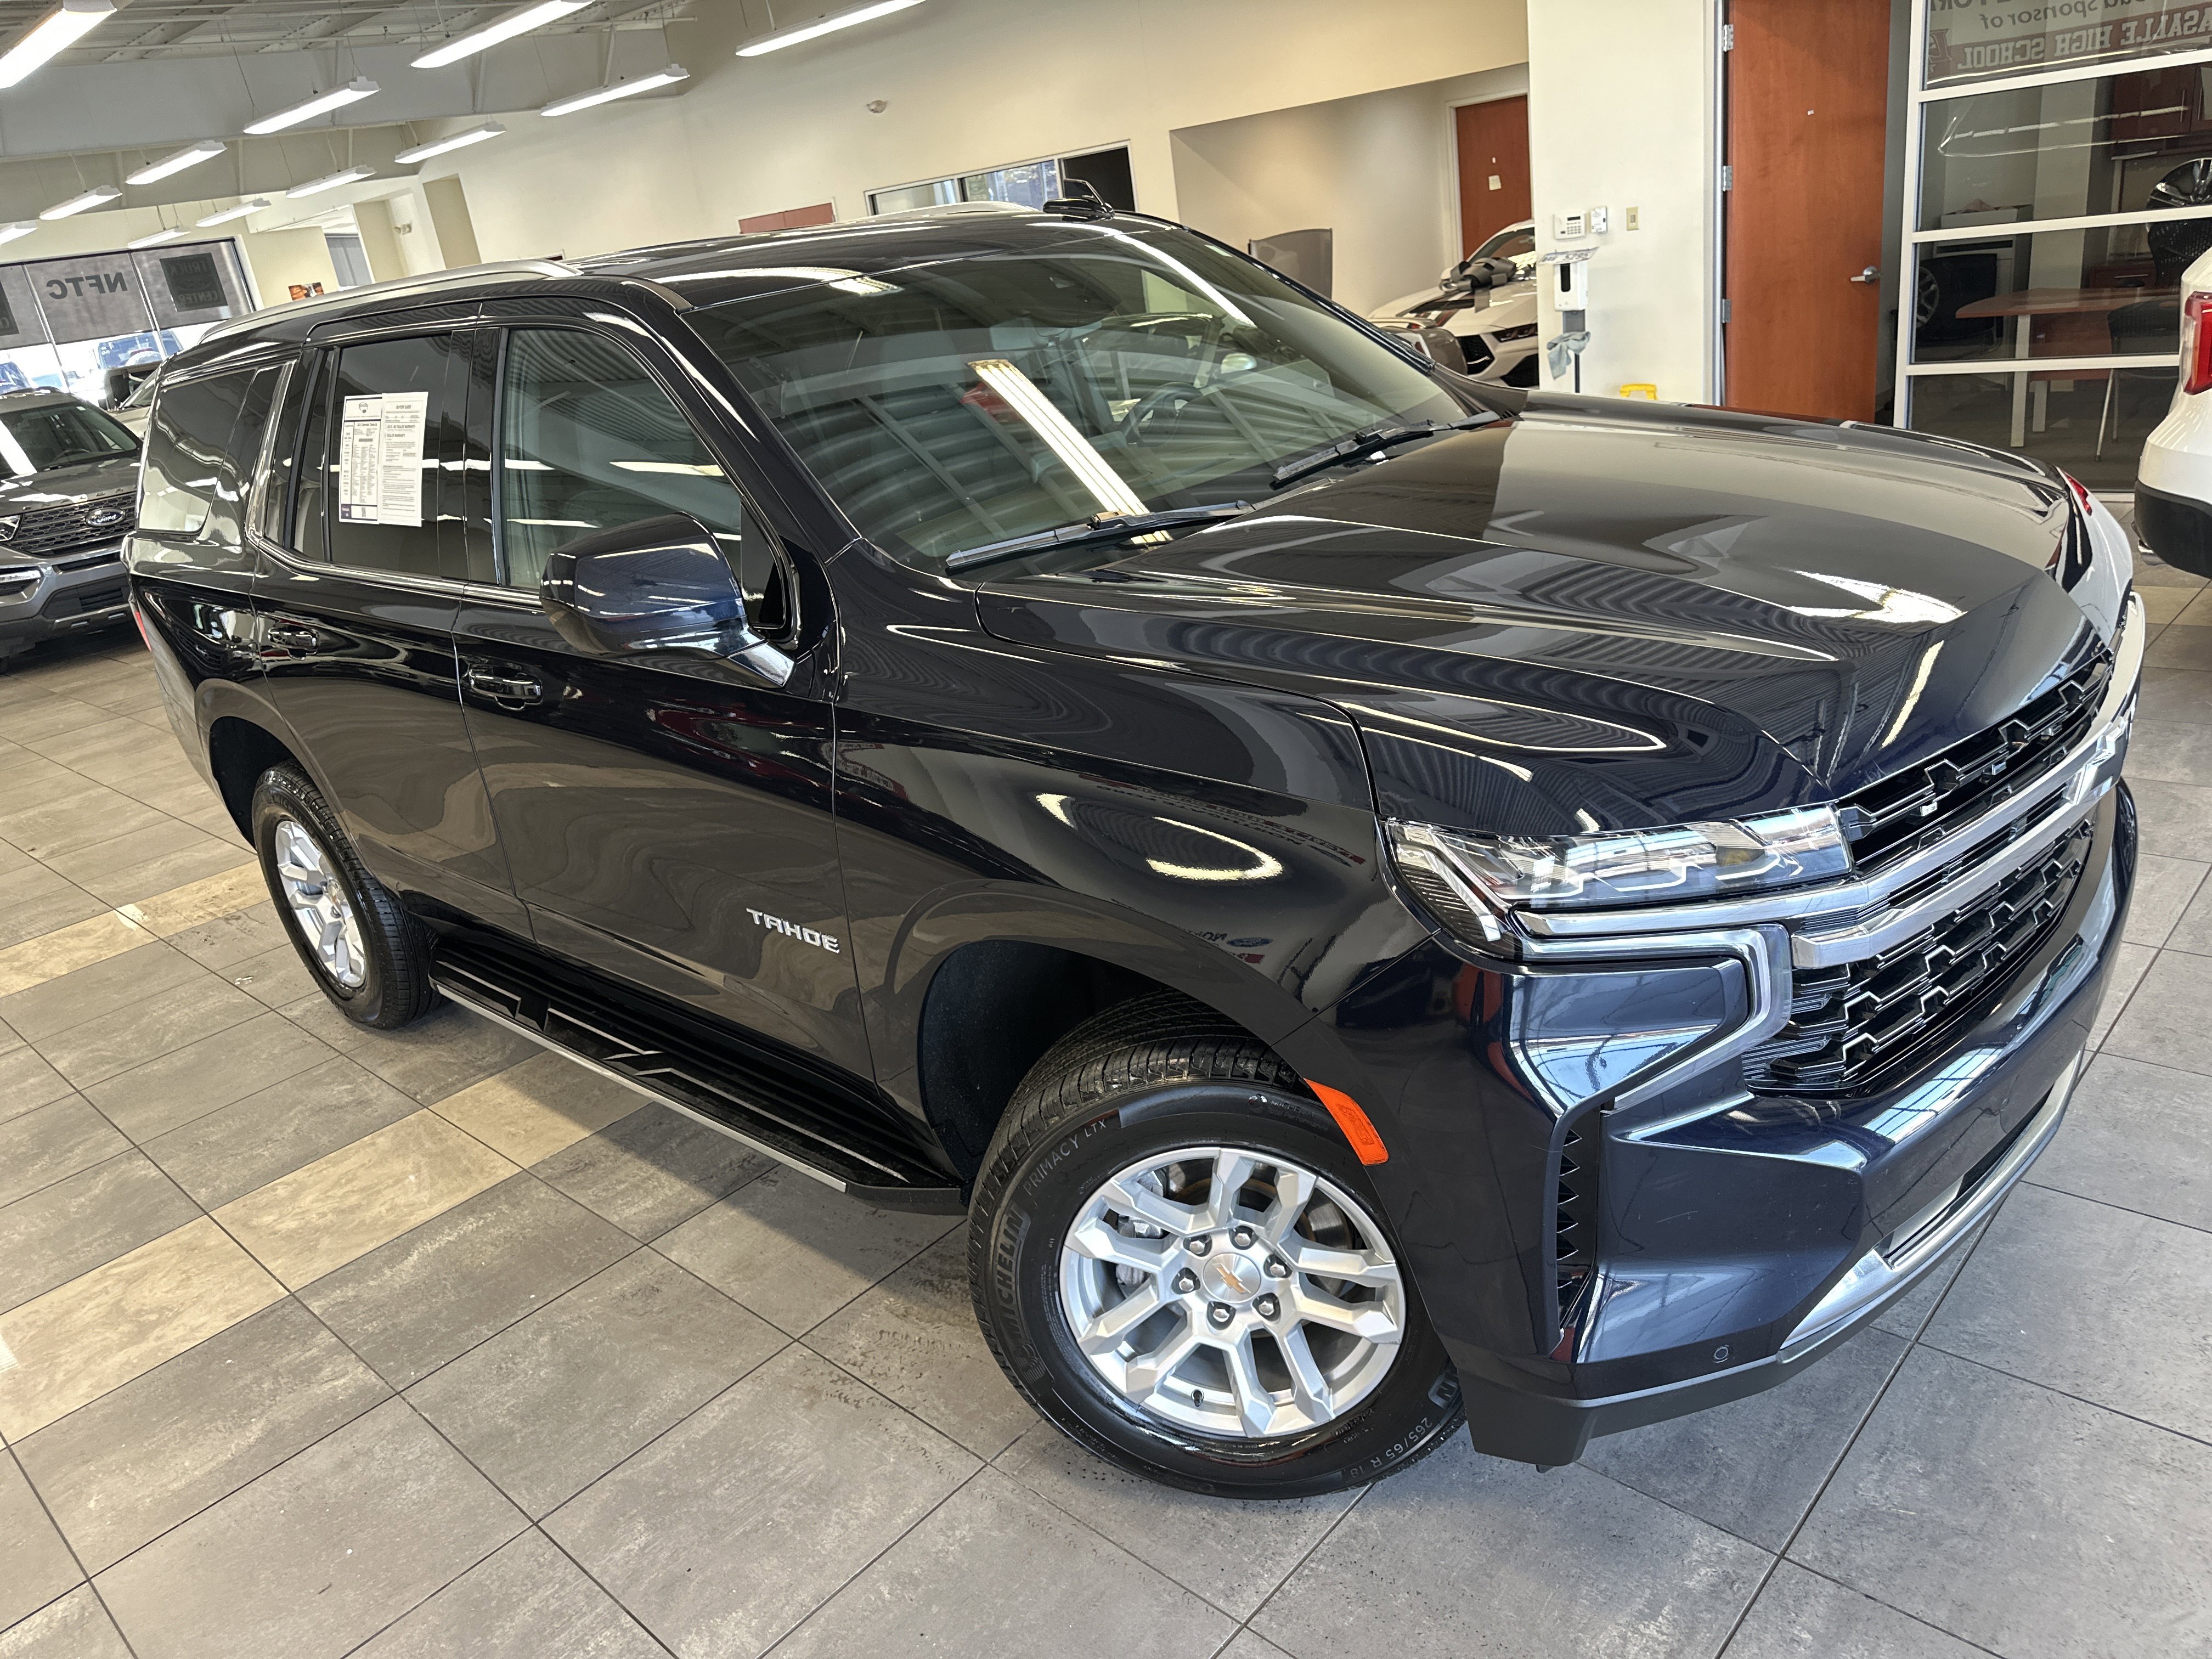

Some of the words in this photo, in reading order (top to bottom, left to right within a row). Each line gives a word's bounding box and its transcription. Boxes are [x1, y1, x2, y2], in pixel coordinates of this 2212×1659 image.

[746, 907, 840, 953] TAHOE
[1023, 1133, 1079, 1197] PRIMACY
[1084, 1119, 1107, 1138] LTX
[996, 1207, 1024, 1339] MICHELIN
[1385, 1417, 1433, 1460] 265/65
[1350, 1465, 1364, 1479] 18
[1370, 1456, 1383, 1469] R
